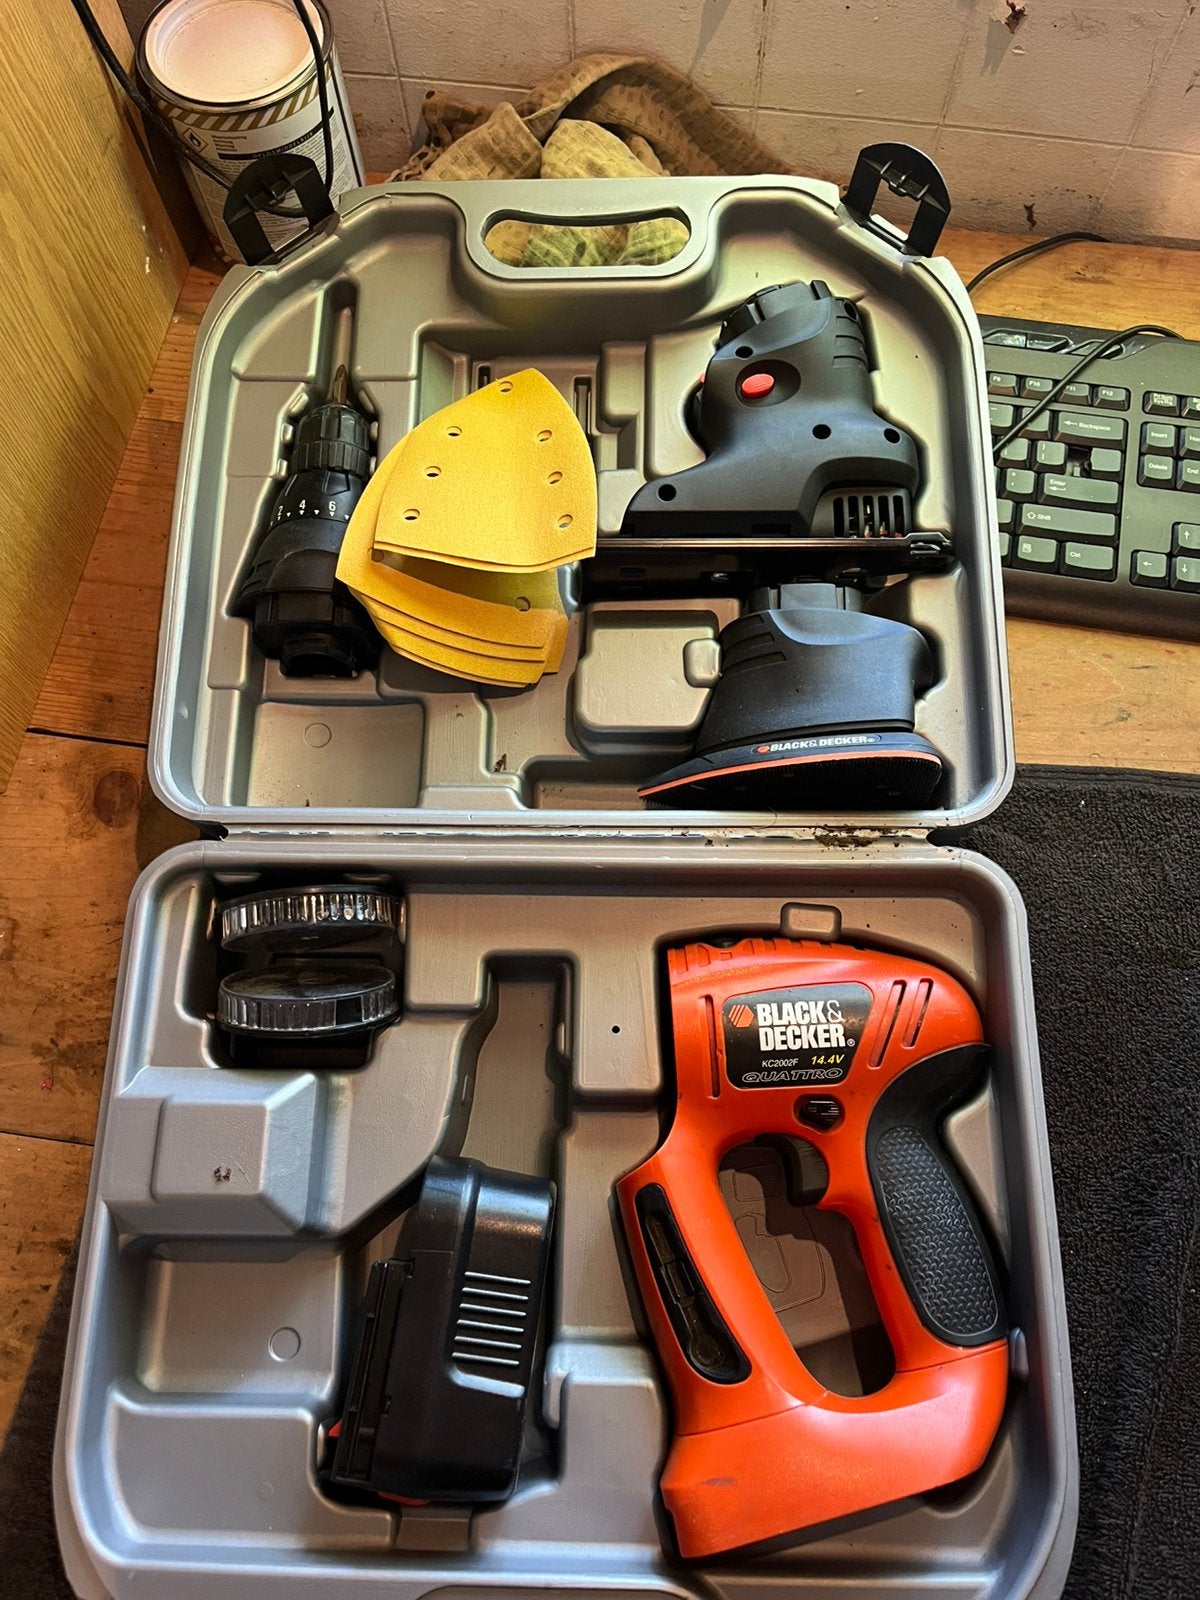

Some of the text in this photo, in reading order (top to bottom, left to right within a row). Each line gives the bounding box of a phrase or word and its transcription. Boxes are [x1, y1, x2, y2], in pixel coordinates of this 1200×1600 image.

[1079, 422, 1111, 431] Backspace
[1148, 462, 1168, 470] Delete
[1187, 467, 1199, 475] End
[1049, 479, 1066, 487] Enter
[299, 500, 306, 509] 4
[328, 501, 337, 511] 6
[819, 736, 867, 747] DECKER
[758, 1024, 846, 1051] DECKER
[761, 1054, 845, 1068] KC2002F 14.4V
[741, 1067, 843, 1083] QUATTRO
